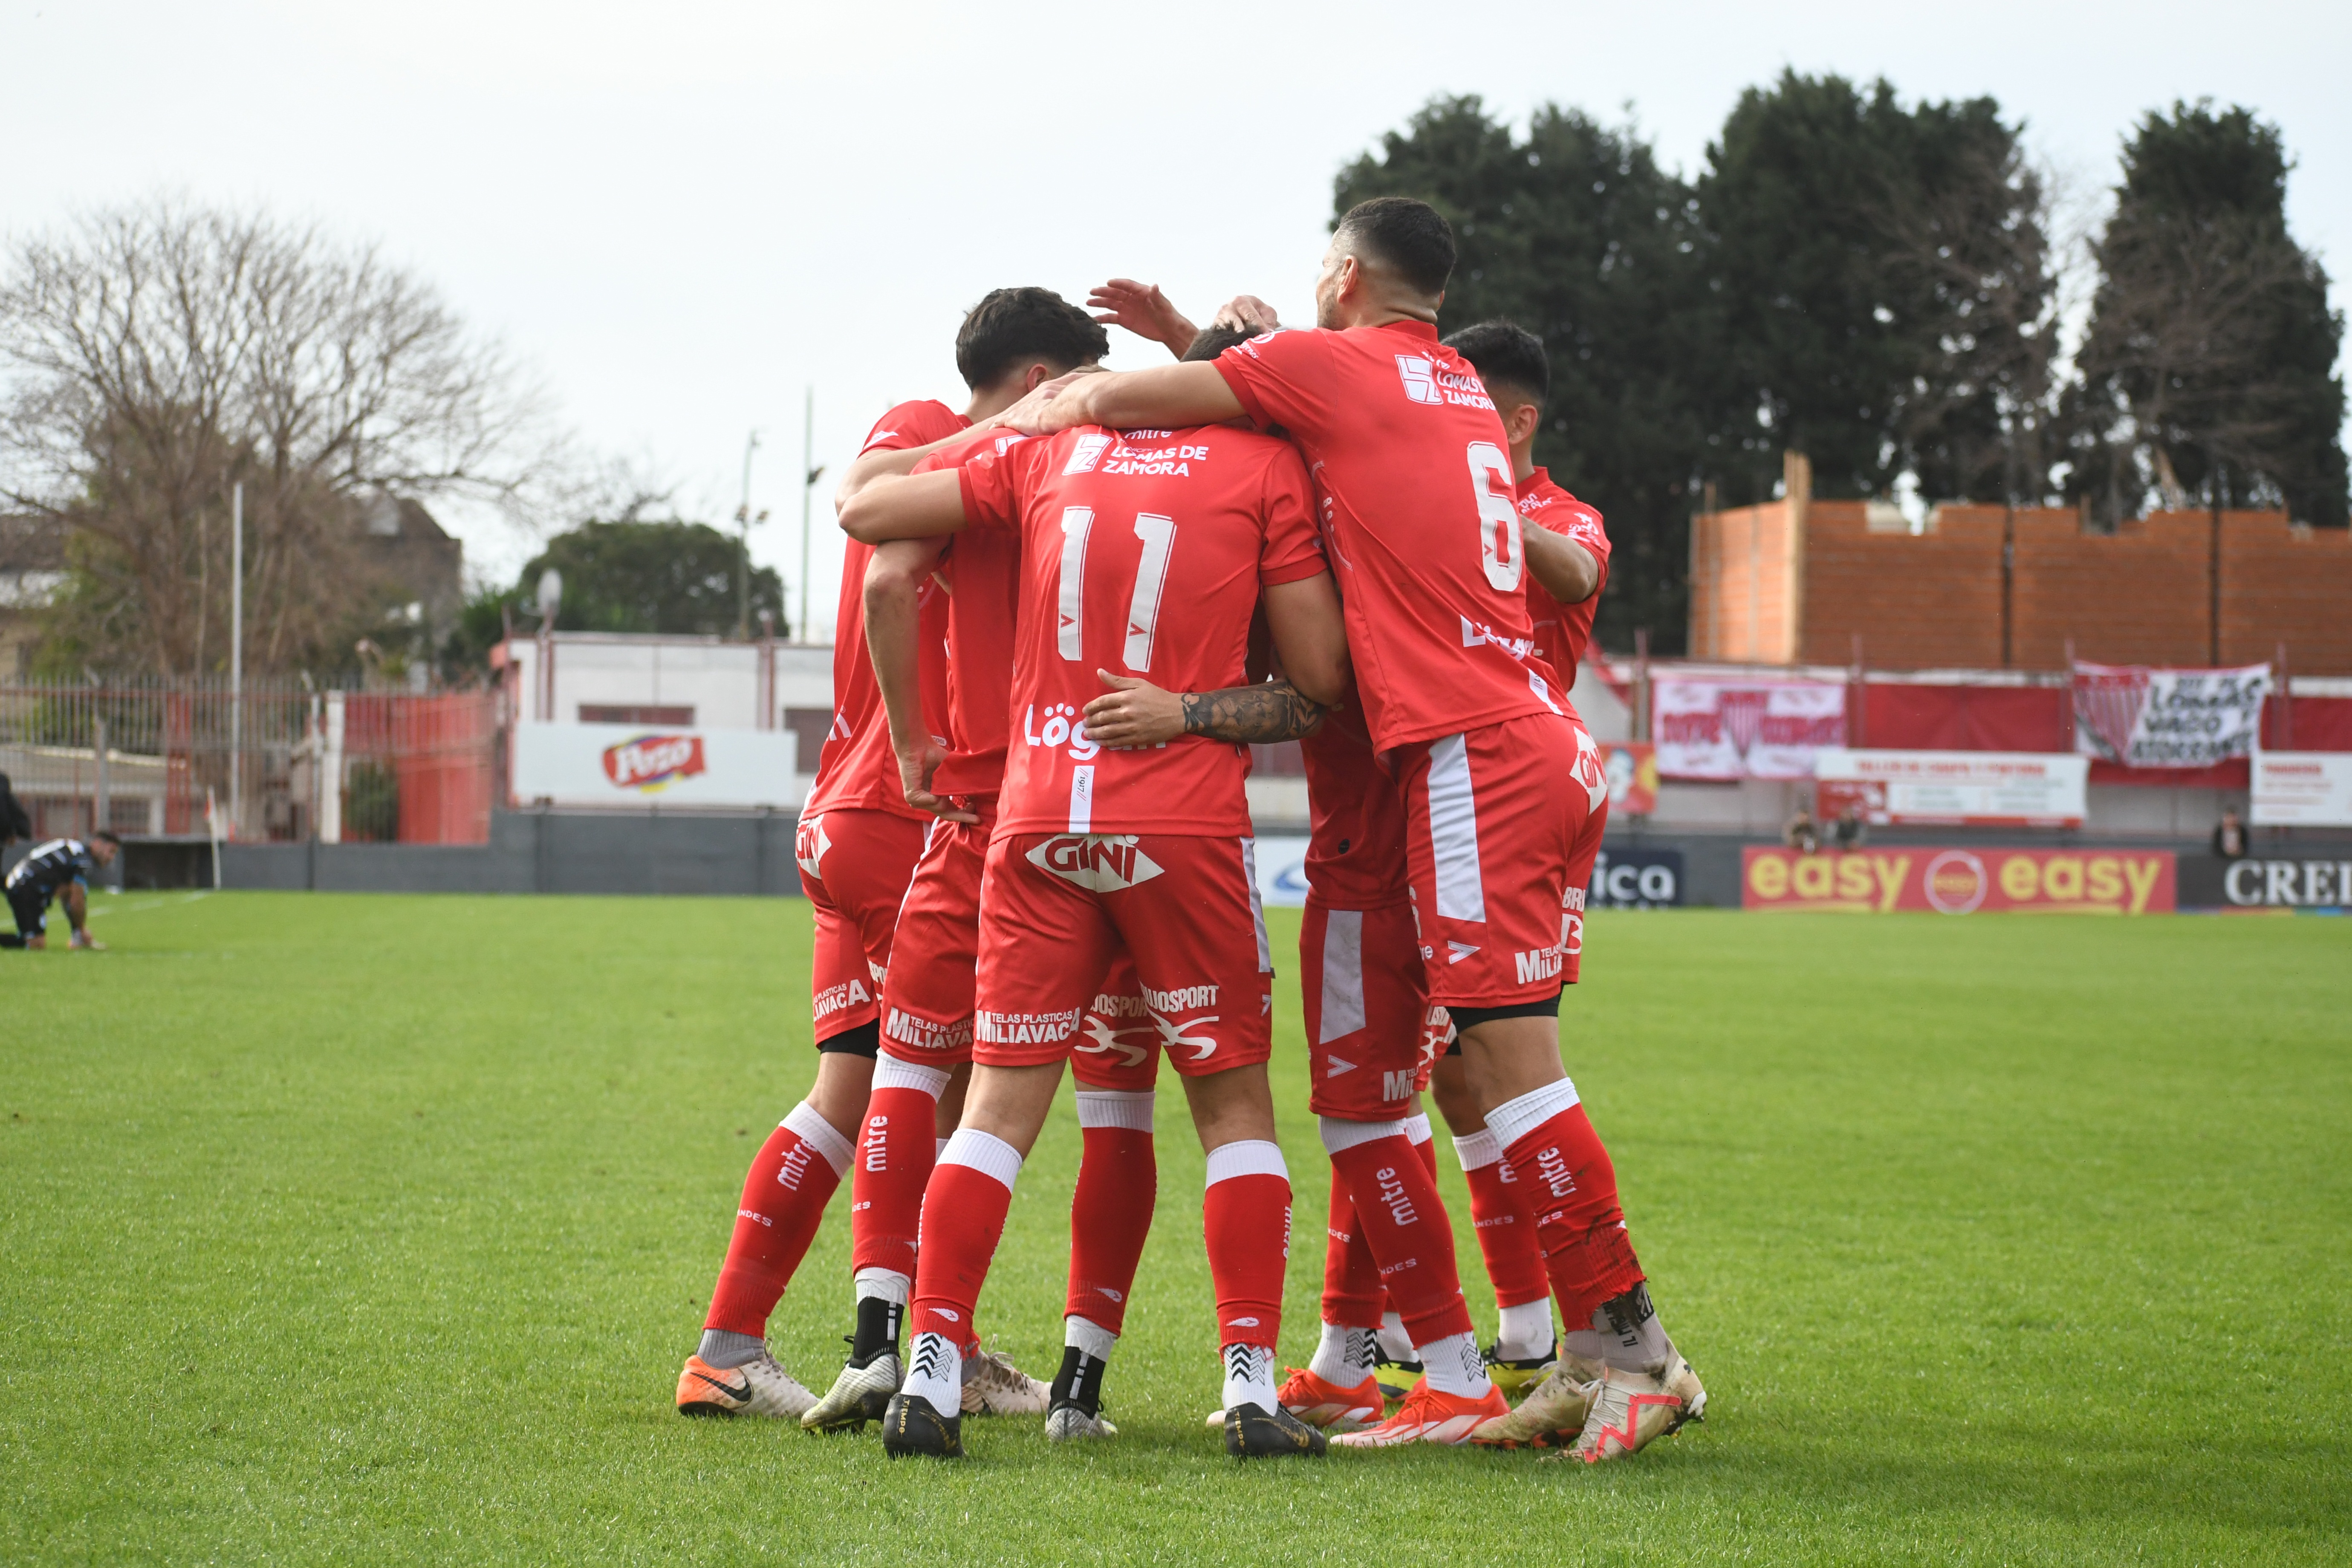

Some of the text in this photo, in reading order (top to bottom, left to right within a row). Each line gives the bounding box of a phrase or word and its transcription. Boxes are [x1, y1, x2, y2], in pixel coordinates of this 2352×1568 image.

[1102, 459, 1189, 477] ZAMORA
[1179, 445, 1209, 461] DE
[1467, 441, 1526, 592] 6
[1058, 506, 1177, 673] 11
[1749, 854, 1911, 913] easy
[1999, 856, 2161, 915] easy
[818, 983, 847, 1001] PLASTICAS
[911, 1016, 938, 1033] TELAS
[976, 1007, 1081, 1043] MILIAVACA
[992, 1011, 1073, 1024] TELAS PLASTICAS
[863, 1115, 888, 1172] mitre
[1537, 1147, 1577, 1198] mitre
[1376, 1167, 1419, 1226] mitre
[899, 1399, 910, 1433] TIEMPO
